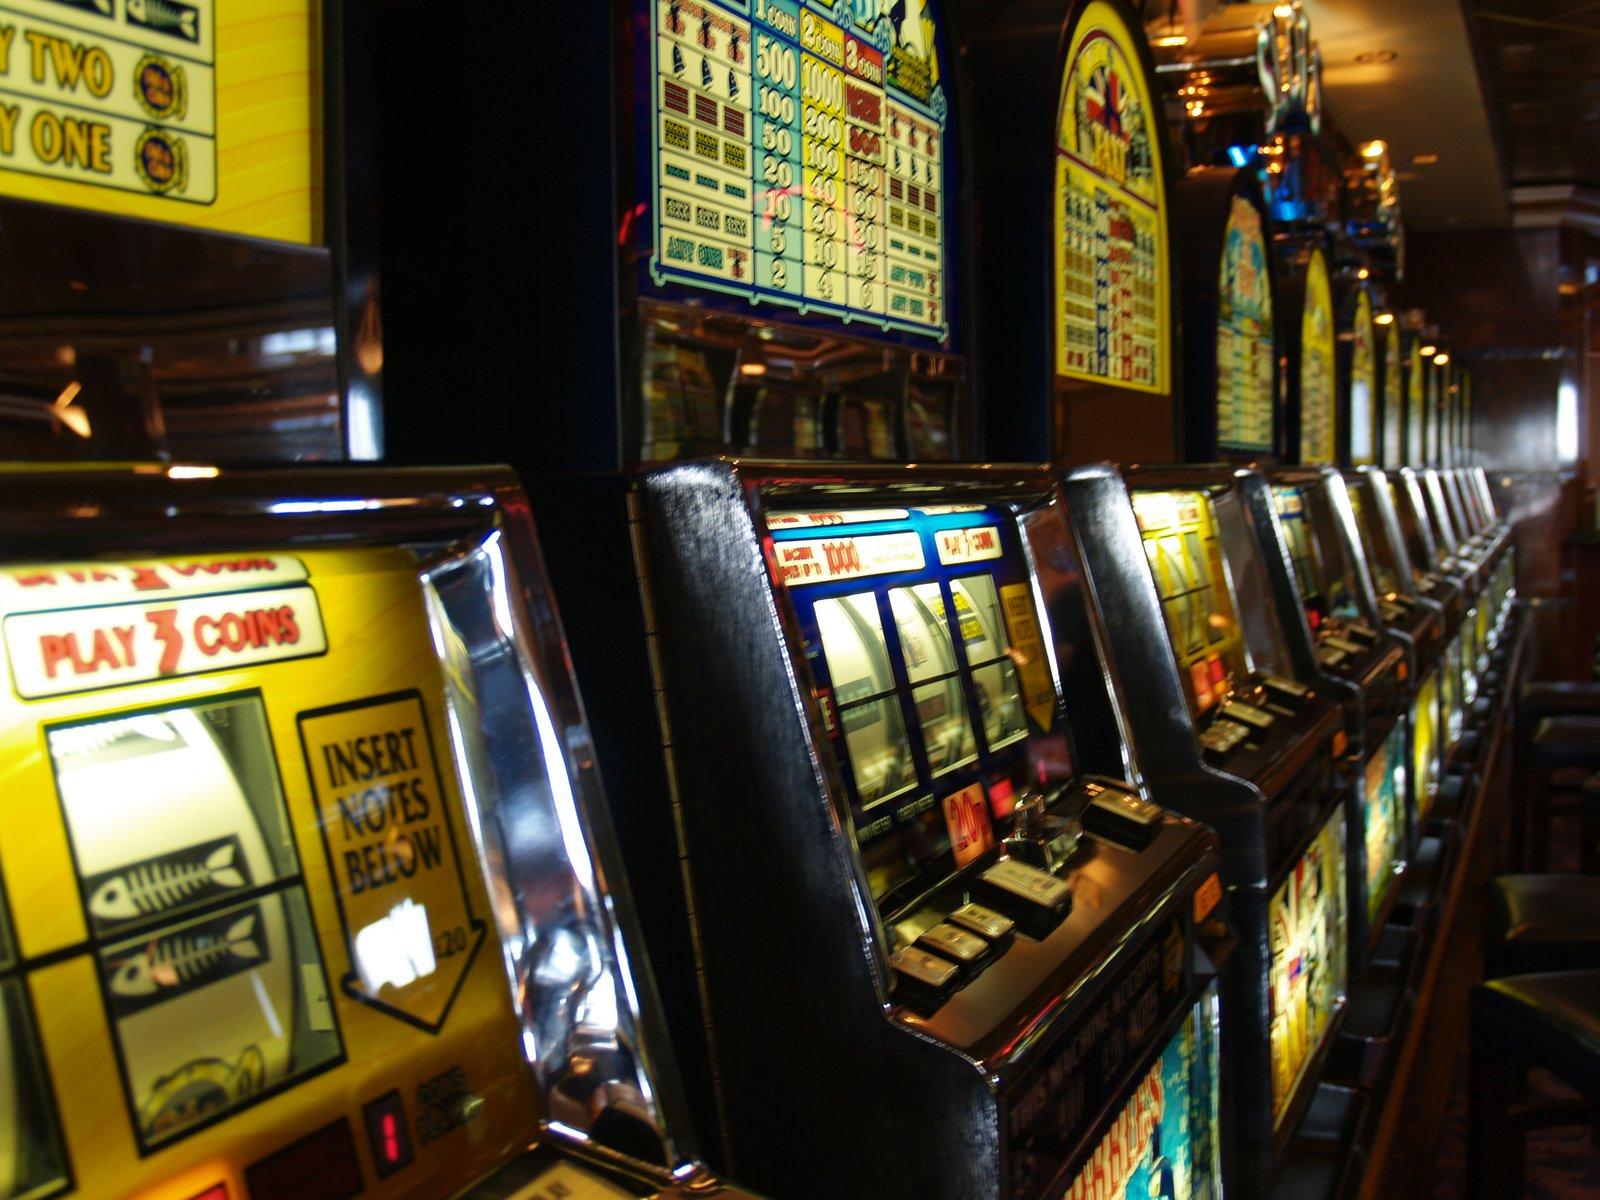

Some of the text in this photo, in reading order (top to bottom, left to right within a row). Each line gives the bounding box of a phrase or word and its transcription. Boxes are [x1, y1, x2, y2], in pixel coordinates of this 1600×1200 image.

[25, 29, 114, 100] TWO
[756, 33, 796, 90] 500
[759, 85, 795, 125] 100
[802, 59, 843, 113] 1000
[30, 109, 112, 175] ONE
[762, 120, 792, 156] 50
[806, 106, 841, 146] 200
[762, 155, 793, 188] 20
[809, 141, 839, 175] 100
[766, 189, 791, 221] 10
[812, 203, 838, 236] 20
[771, 222, 786, 255] 5
[815, 238, 837, 270] 10
[771, 257, 787, 290] 2
[40, 605, 299, 678] PLAY 3 COINS
[322, 728, 419, 788] INSERT
[337, 778, 430, 841] NOTES
[344, 825, 443, 894] BELOW
